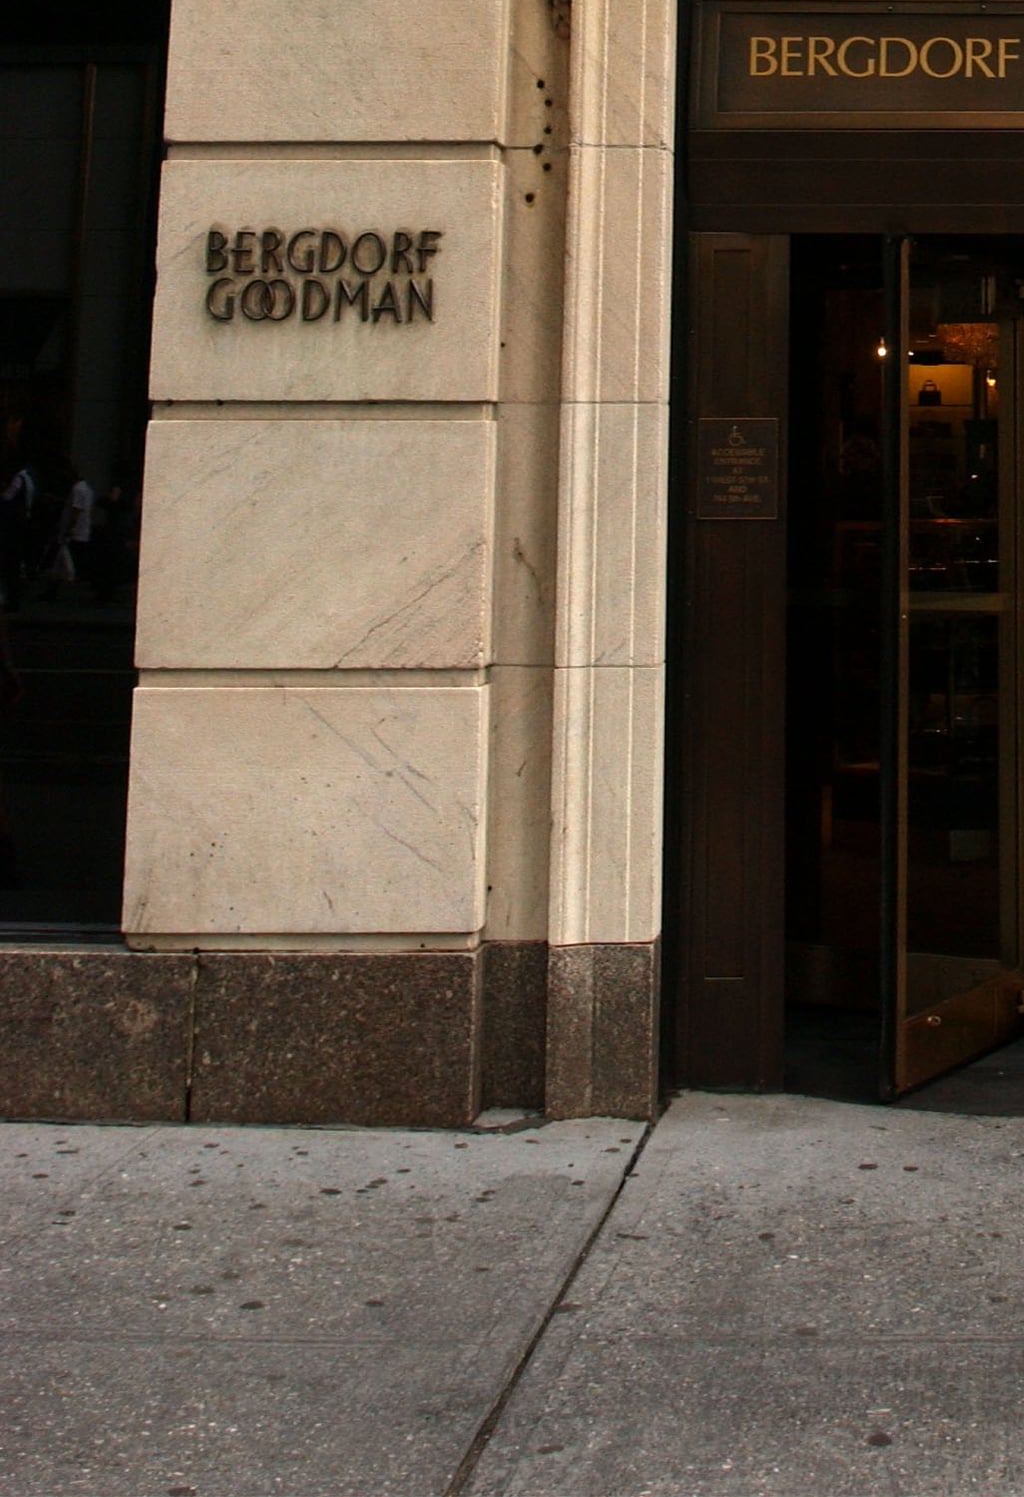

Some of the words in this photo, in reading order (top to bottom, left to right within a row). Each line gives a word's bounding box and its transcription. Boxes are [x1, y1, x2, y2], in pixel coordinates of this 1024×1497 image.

[748, 36, 1020, 79] BERGDORF
[206, 230, 444, 274] BERGDORF
[206, 278, 434, 323] GOODMAN
